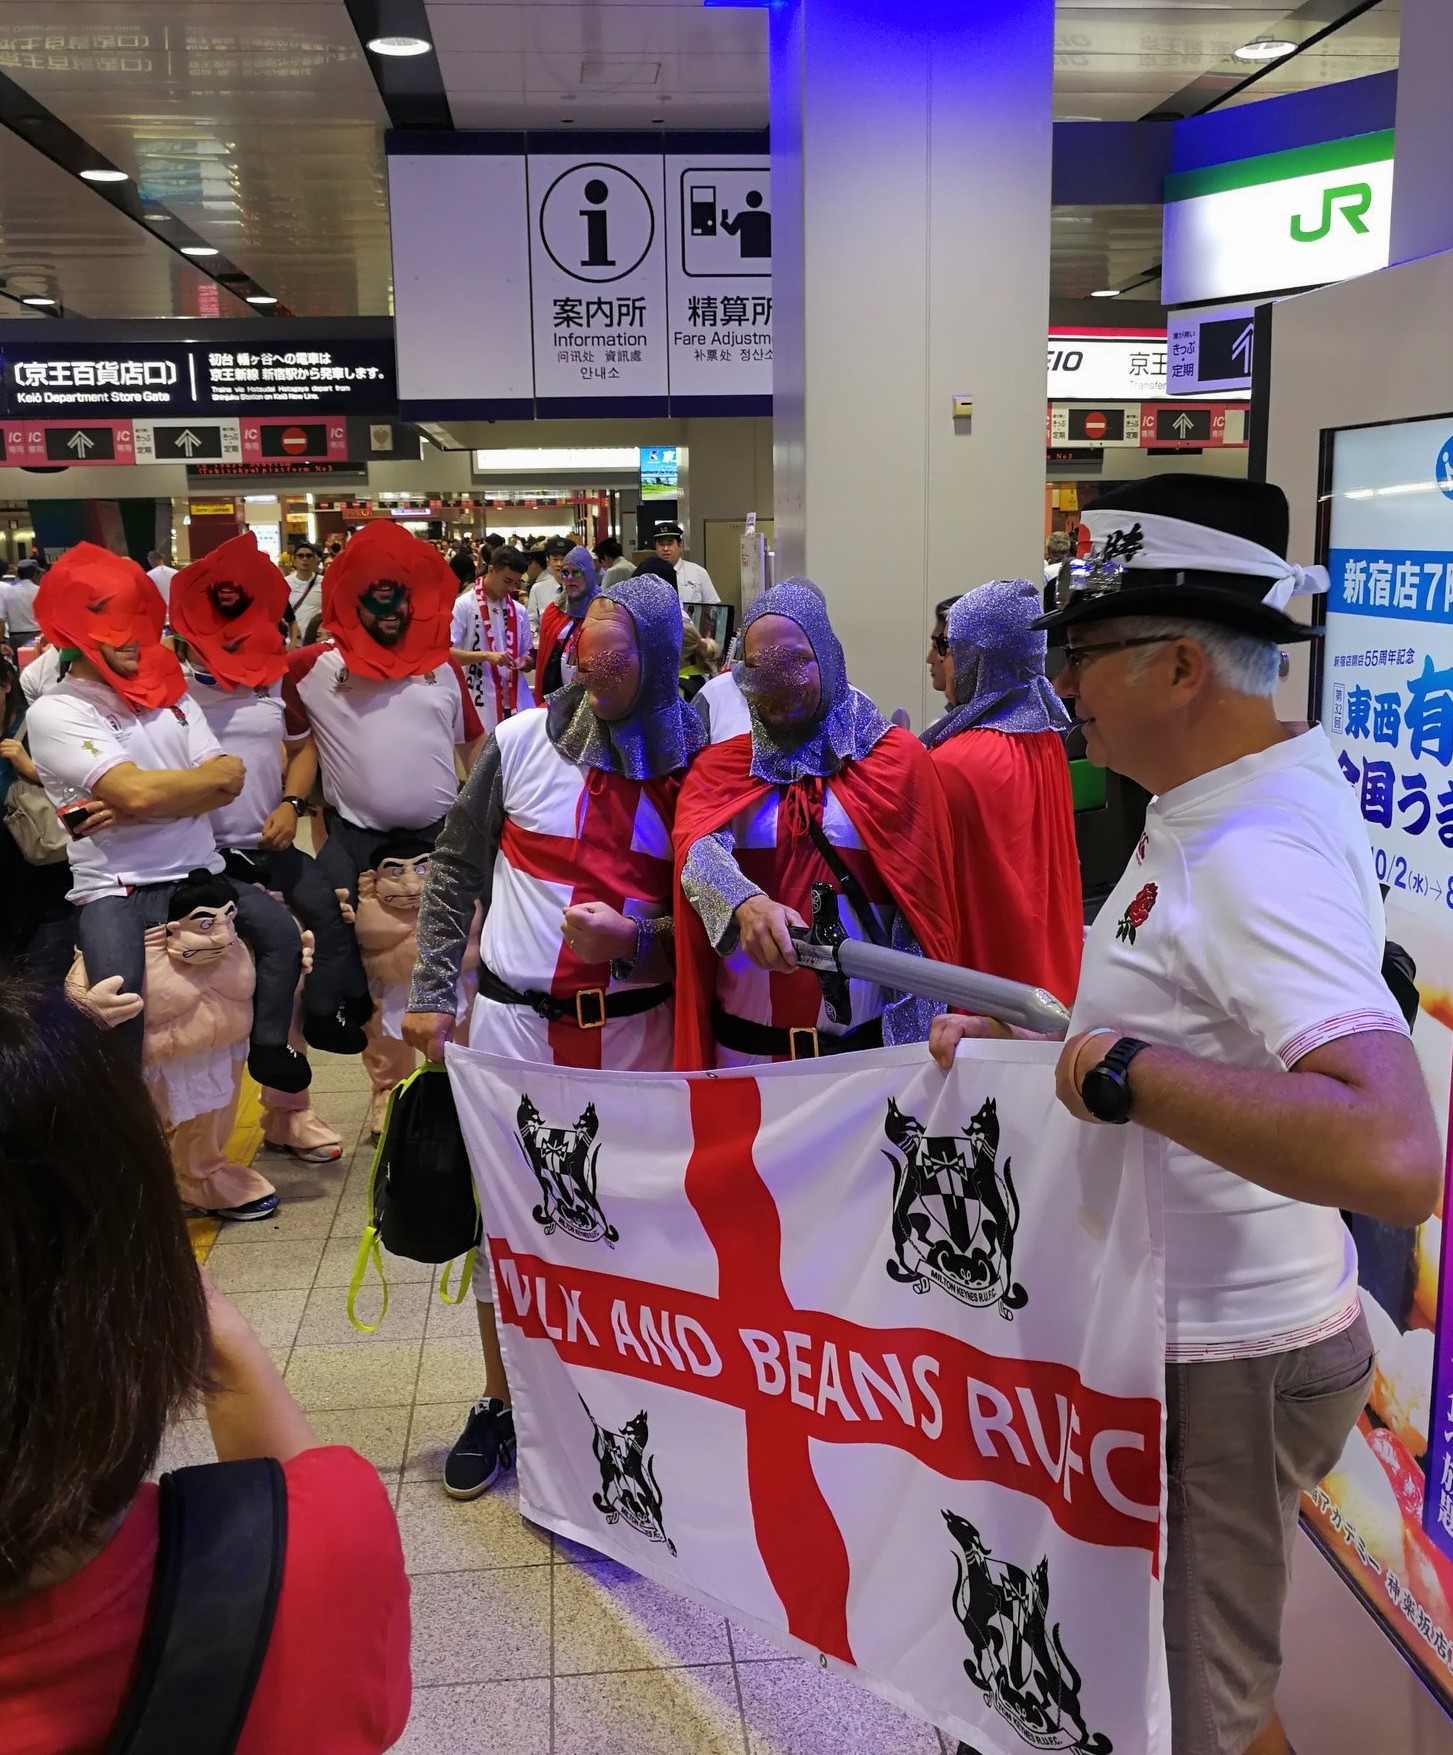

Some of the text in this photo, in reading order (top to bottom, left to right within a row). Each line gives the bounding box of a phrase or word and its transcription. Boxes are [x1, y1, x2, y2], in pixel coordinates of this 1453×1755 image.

[1290, 182, 1372, 243] JR
[553, 296, 646, 328] 案内所
[554, 332, 647, 347] Information
[674, 331, 772, 347] Fare Adjustm
[1172, 341, 1196, 356] きっぷ
[208, 353, 233, 366] 初台
[580, 366, 620, 380] 안내소
[1172, 363, 1194, 378] 定期
[44, 392, 109, 404] Department
[110, 391, 142, 402] Store
[143, 390, 170, 402] Gate
[1142, 416, 1155, 427] IC
[1213, 416, 1226, 427] IC
[9, 432, 22, 443] IC
[28, 432, 42, 443] IC
[117, 431, 130, 441] IC
[244, 429, 258, 440] IC
[331, 428, 344, 439] IC
[1343, 558, 1453, 613] 新宿店7
[930, 1270, 956, 1293] MILTON
[956, 1285, 978, 1302] KEYNES
[610, 1299, 723, 1377] AND
[738, 1328, 943, 1440] BEANS
[966, 1376, 1161, 1523] RUFC
